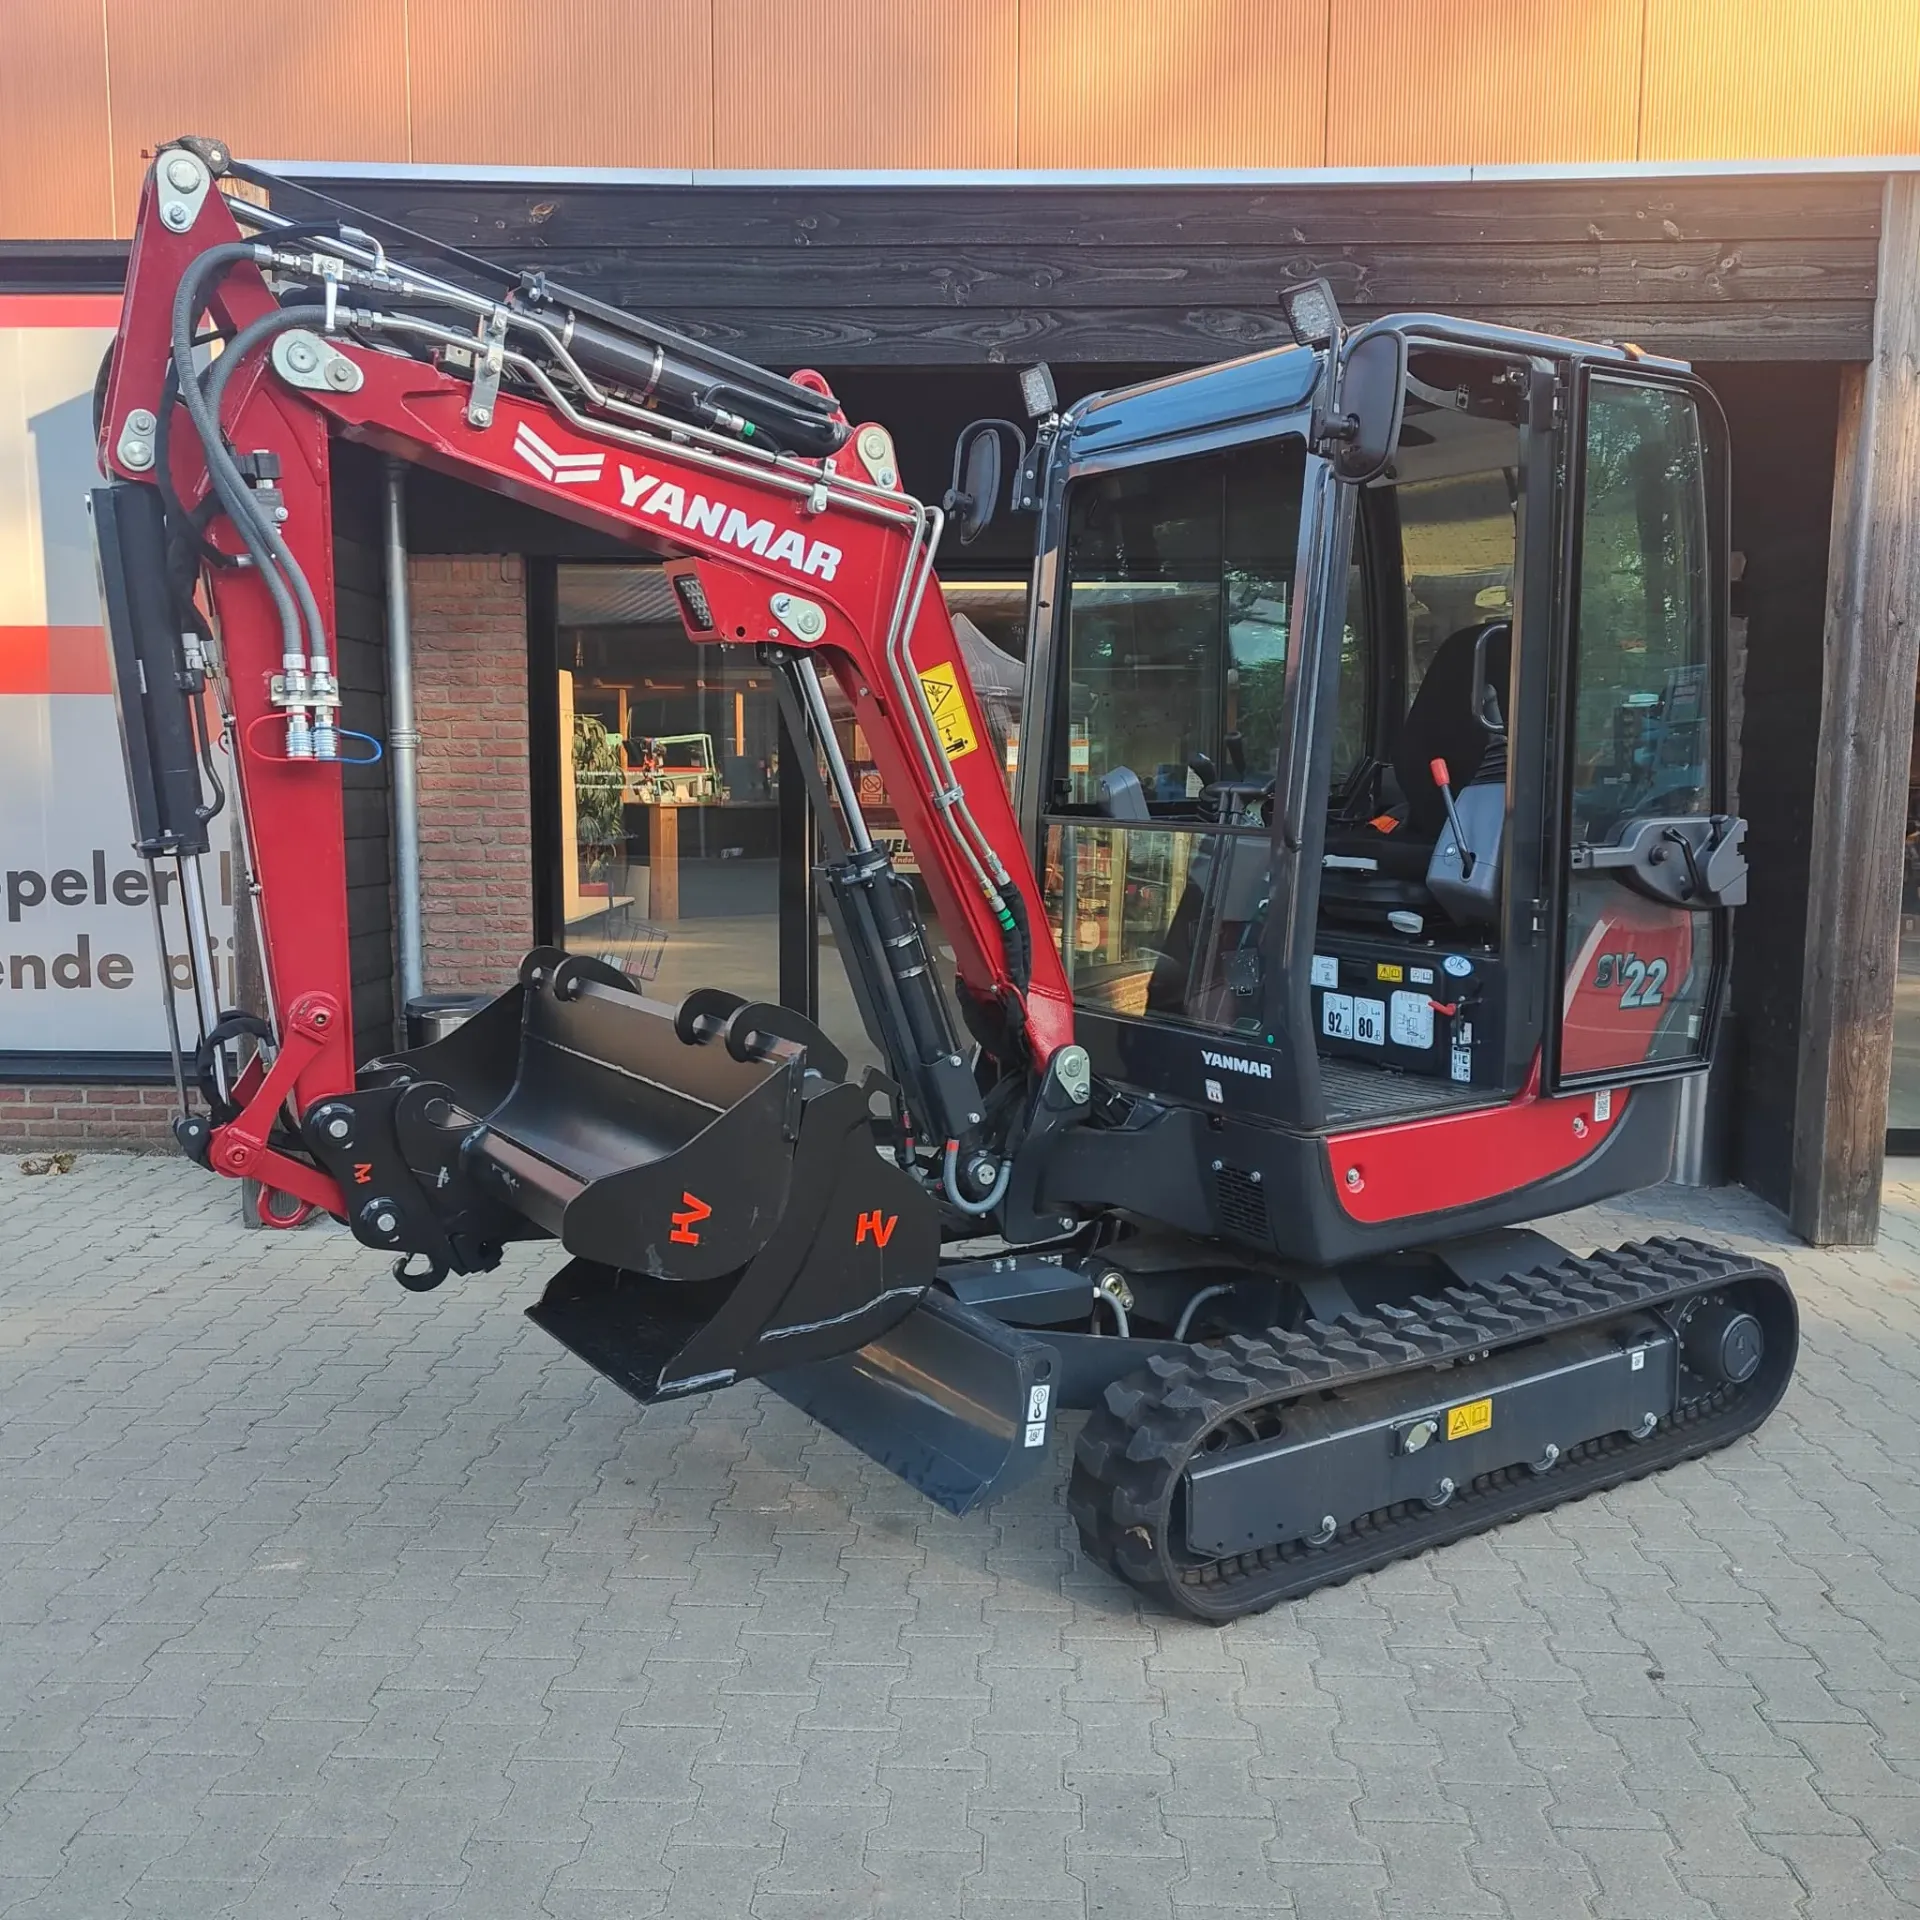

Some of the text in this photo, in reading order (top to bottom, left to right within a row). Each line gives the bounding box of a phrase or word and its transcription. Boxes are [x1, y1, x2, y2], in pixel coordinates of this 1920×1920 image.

[618, 464, 842, 582] YANMAR
[0, 850, 178, 922] pele
[0, 934, 134, 990] ende
[1328, 1011, 1342, 1033] 92
[1358, 1017, 1373, 1038] 80
[1200, 1050, 1272, 1079] YANMAR
[670, 1191, 712, 1245] HV
[855, 1209, 899, 1248] HV
